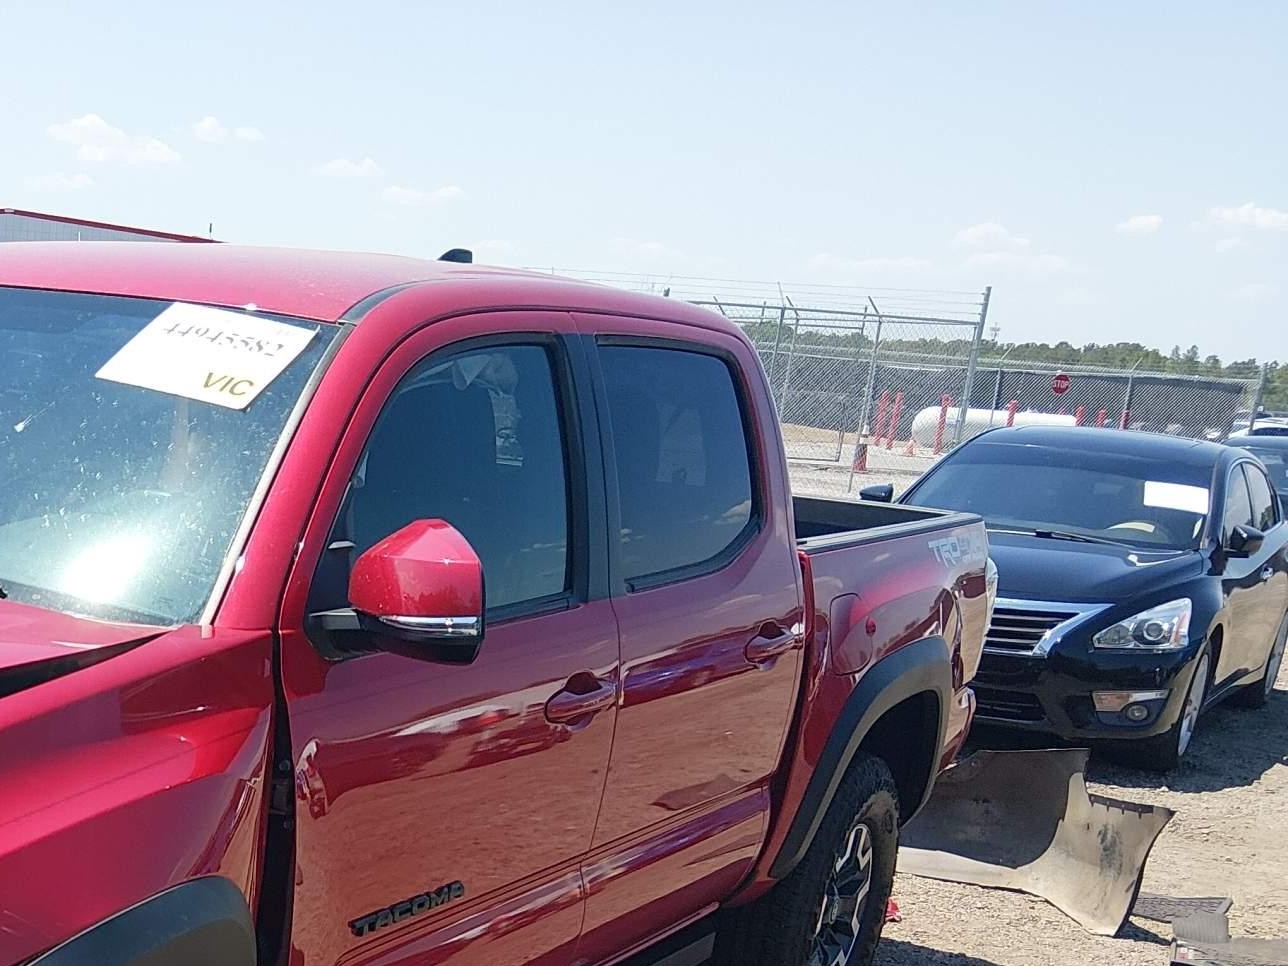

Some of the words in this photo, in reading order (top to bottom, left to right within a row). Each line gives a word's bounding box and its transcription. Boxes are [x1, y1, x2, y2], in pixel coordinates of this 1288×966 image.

[203, 371, 255, 397] VIC
[1052, 379, 1070, 389] STOP
[348, 880, 465, 937] TACOMA
